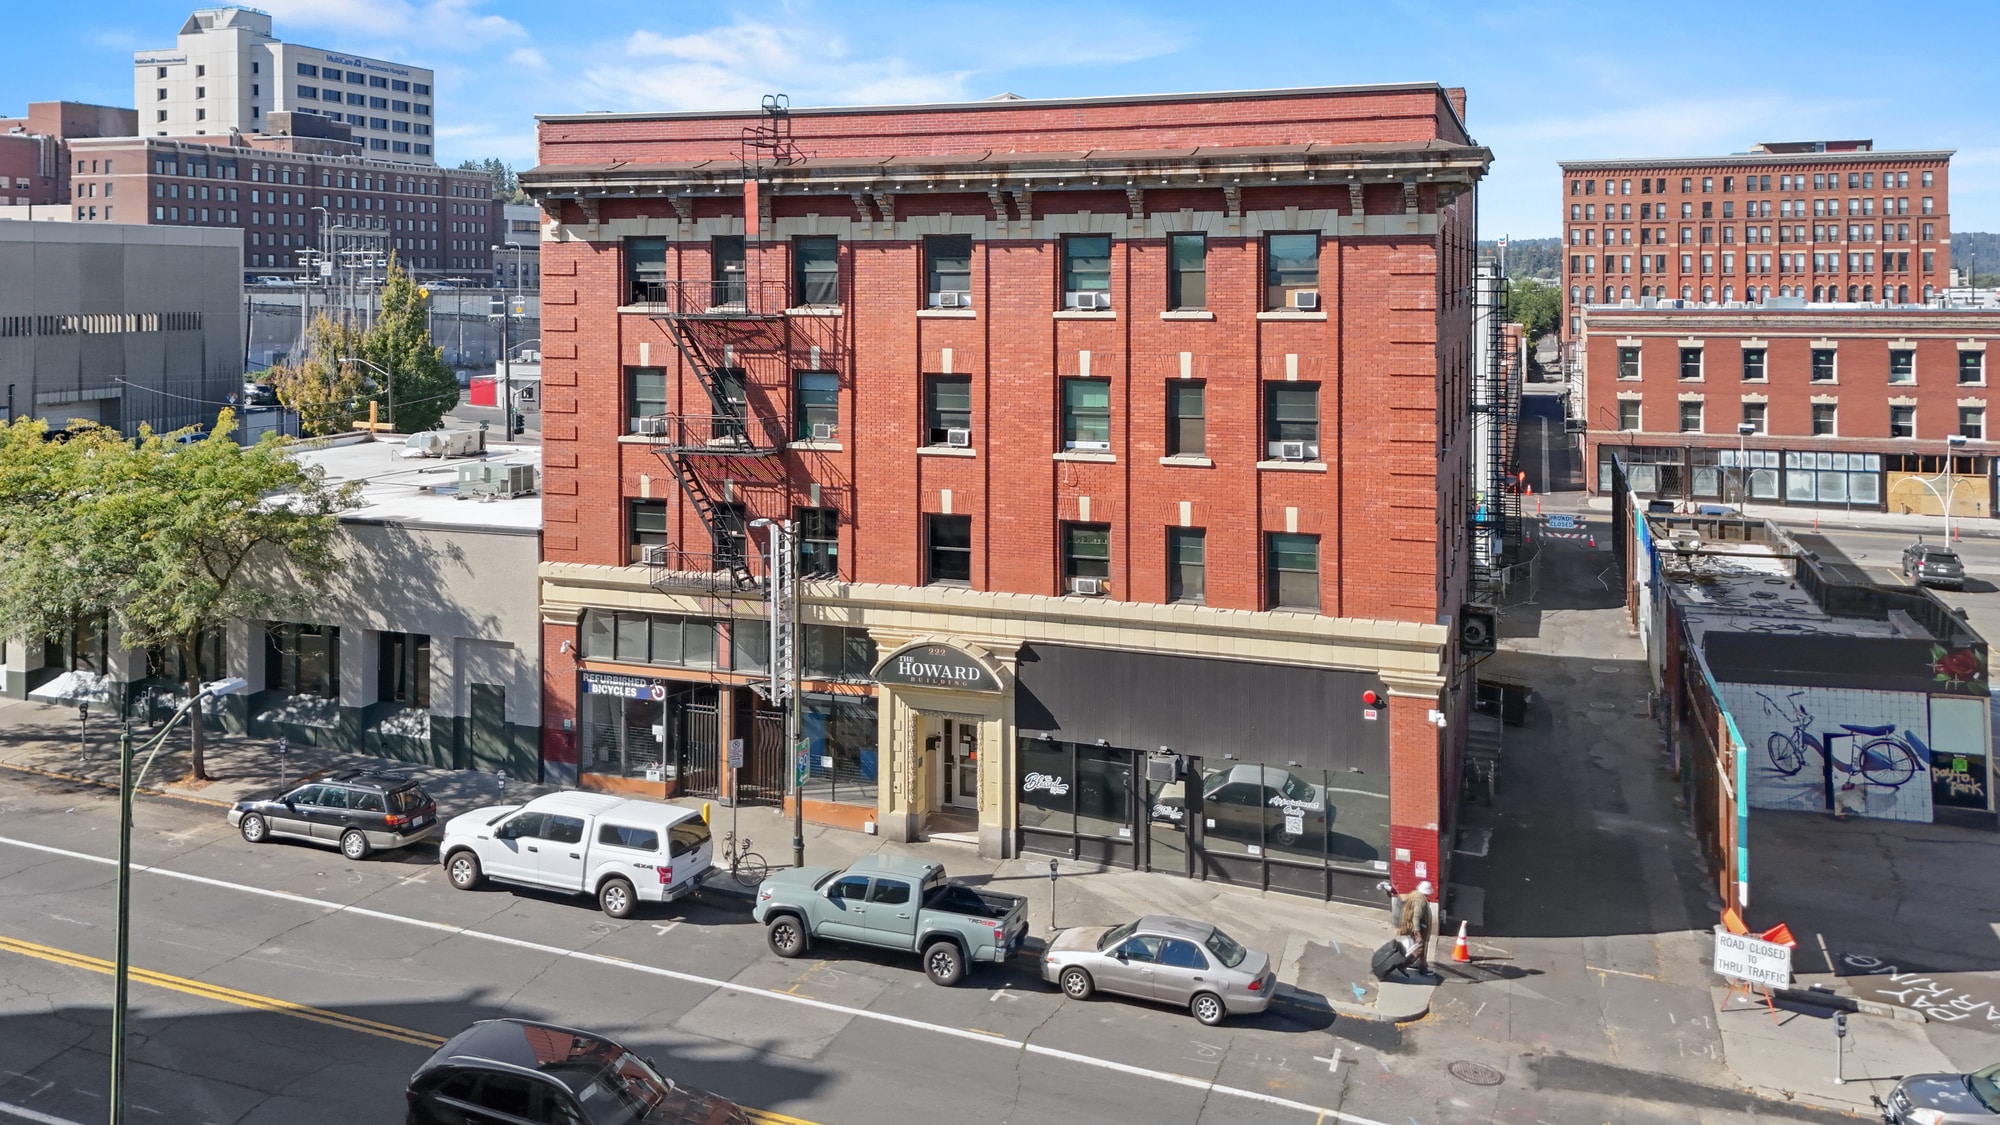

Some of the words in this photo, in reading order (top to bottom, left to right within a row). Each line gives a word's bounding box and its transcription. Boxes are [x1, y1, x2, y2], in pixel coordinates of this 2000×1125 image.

[326, 54, 354, 66] MultiCare
[389, 67, 409, 76] Hospital
[928, 648, 946, 656] 222
[898, 662, 980, 680] HOWARD
[583, 673, 647, 688] REFURBISHED
[910, 677, 968, 686] BUILDING
[591, 684, 637, 697] BICYCLES
[798, 753, 808, 770] 90
[1023, 772, 1069, 792] Blessed
[1931, 767, 1955, 783] pay
[1950, 778, 1984, 796] park
[1268, 795, 1320, 809] Appointment
[1719, 936, 1745, 950] ROAD
[1749, 942, 1786, 960] CLOSED
[1748, 954, 1757, 964] TO
[1718, 958, 1743, 973] THRU
[1747, 965, 1786, 984] TRAFFIC
